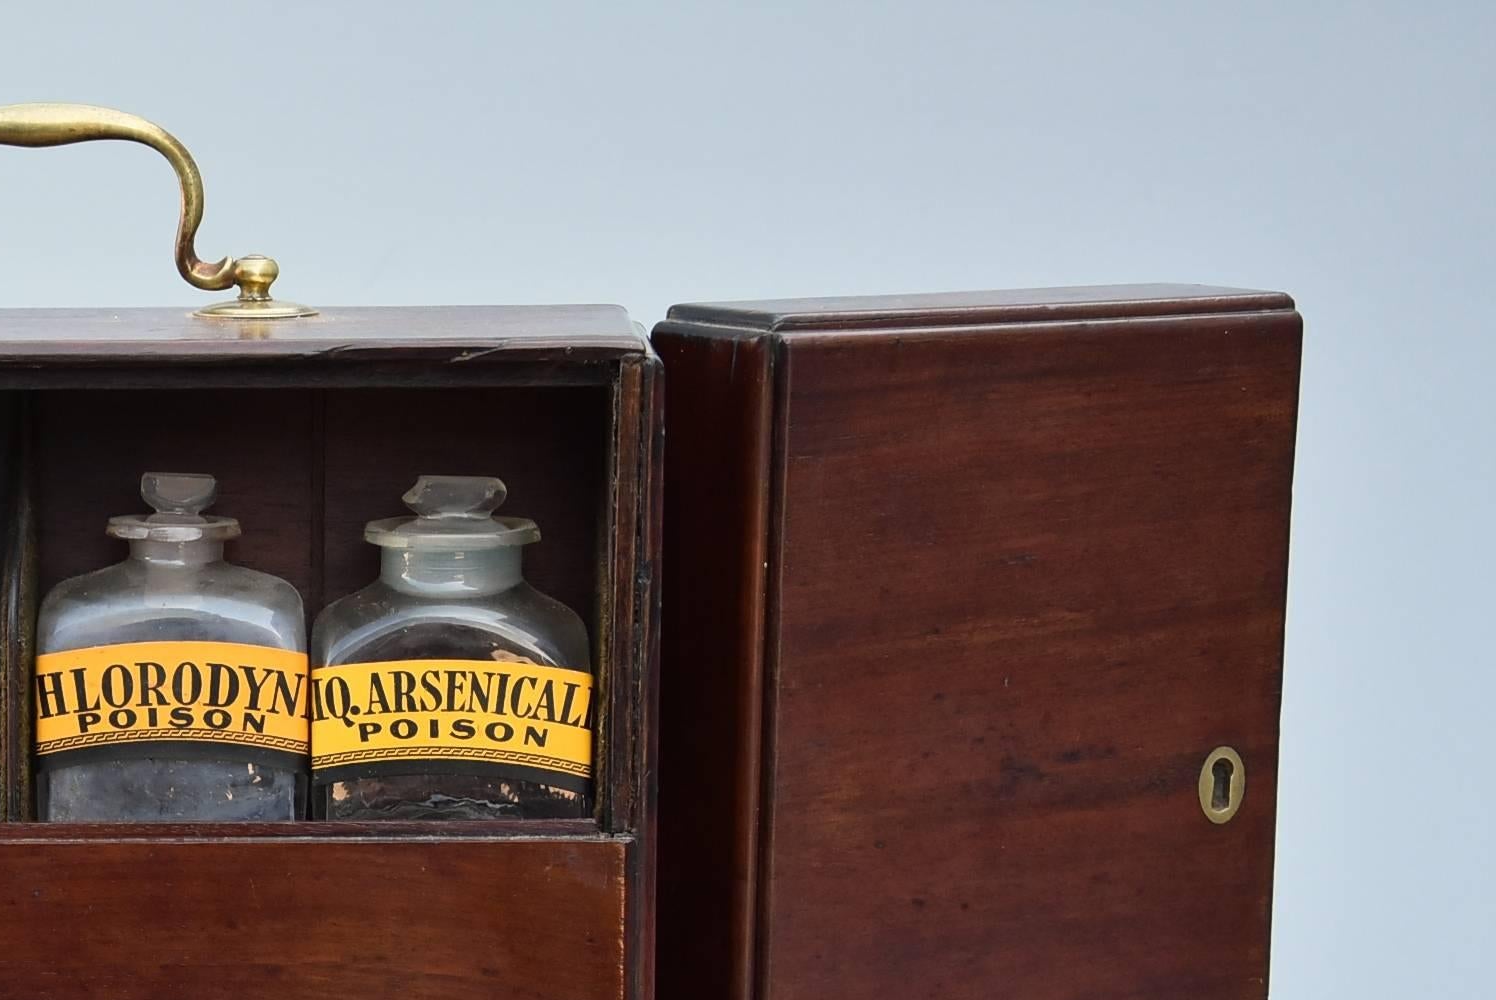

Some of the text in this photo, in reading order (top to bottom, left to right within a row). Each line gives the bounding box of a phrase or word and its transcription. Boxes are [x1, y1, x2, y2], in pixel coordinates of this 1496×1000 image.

[36, 661, 310, 720] HLORODYN
[312, 676, 361, 728] IQ.
[78, 707, 266, 733] POISON
[359, 718, 549, 748] POISON
